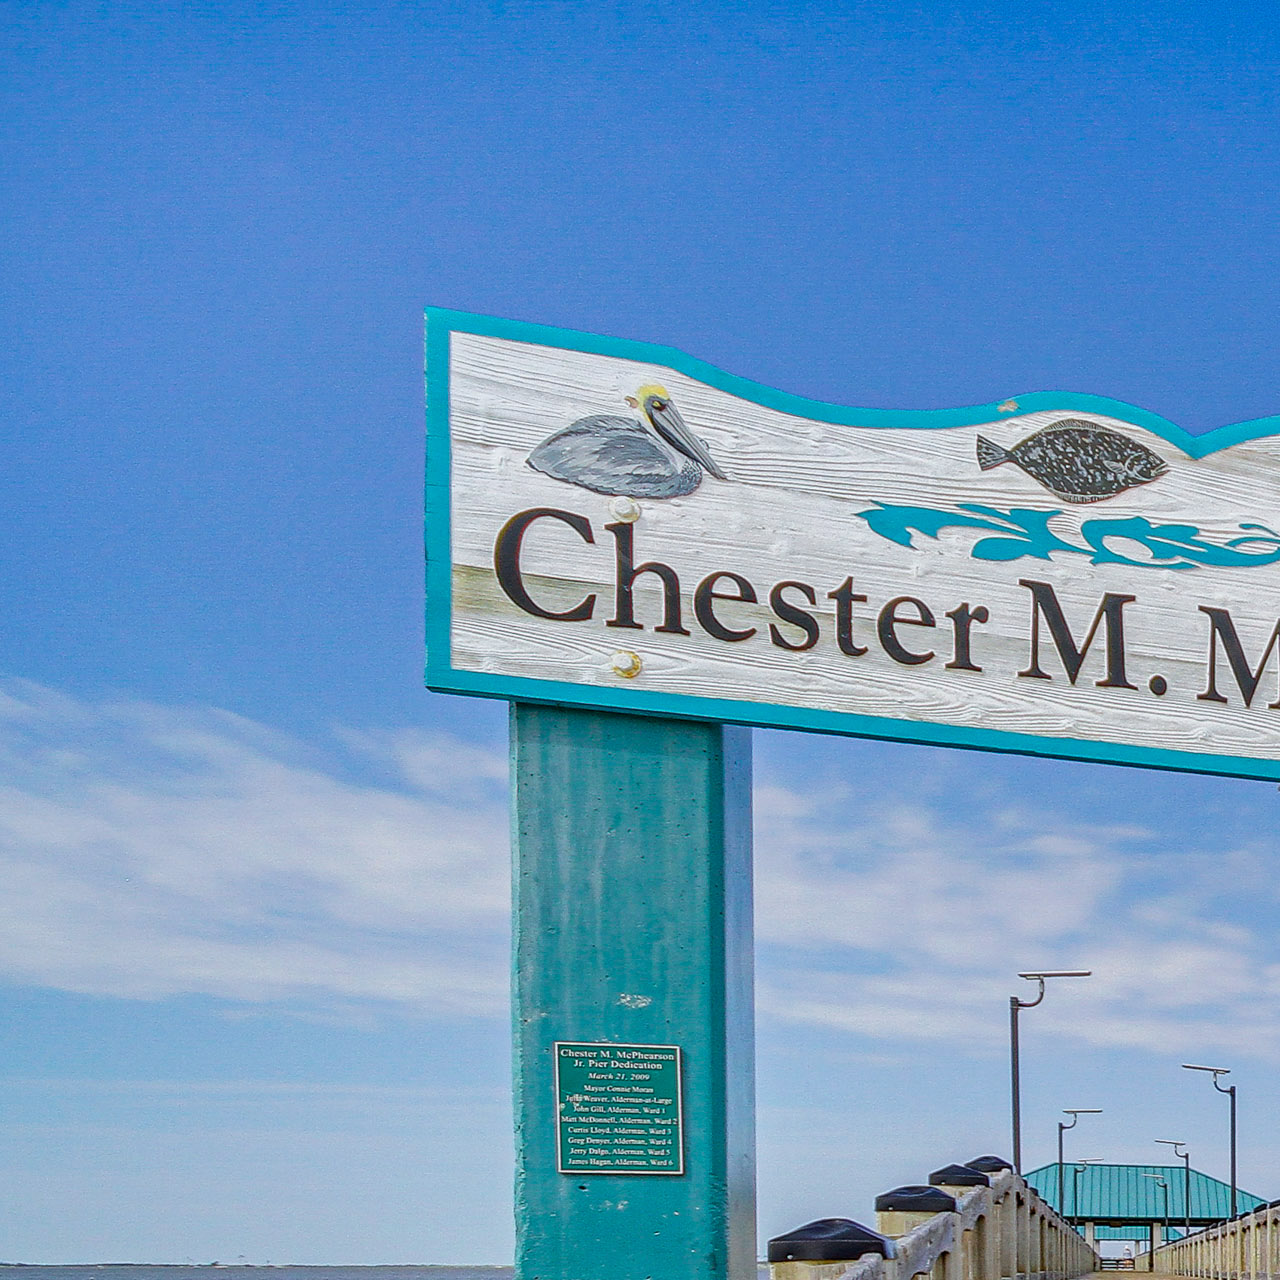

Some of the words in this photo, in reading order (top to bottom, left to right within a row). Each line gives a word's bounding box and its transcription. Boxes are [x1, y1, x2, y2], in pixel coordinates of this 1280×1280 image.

[493, 506, 989, 672] Chester
[1017, 578, 1168, 696] M.
[560, 1049, 597, 1058] Chester
[600, 1050, 613, 1058] M.
[616, 1051, 674, 1060] McPhearson
[573, 1059, 585, 1067] Jr.
[611, 1060, 662, 1069] Dedication
